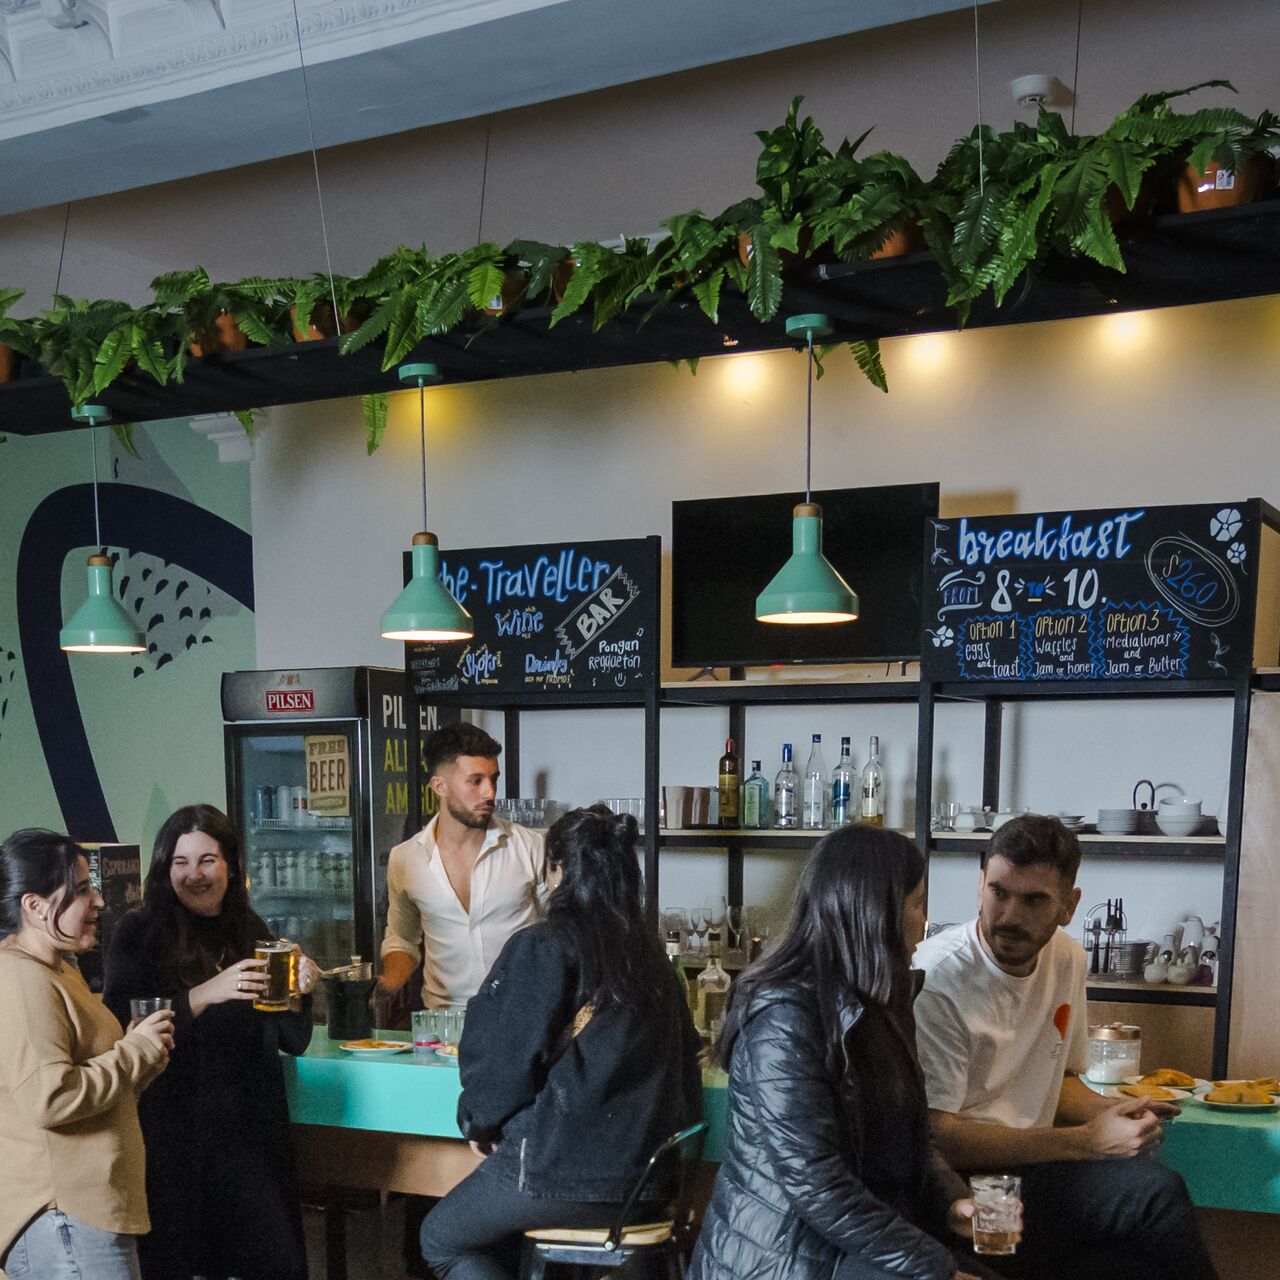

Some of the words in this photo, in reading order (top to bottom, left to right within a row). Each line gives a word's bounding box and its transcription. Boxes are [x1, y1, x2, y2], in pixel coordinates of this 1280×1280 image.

[958, 510, 1145, 565] breakfast
[943, 586, 979, 605] FROM
[990, 569, 1012, 612] 8
[495, 609, 544, 636] Wine
[576, 587, 625, 641] BAR
[1078, 613, 1087, 633] 2
[1147, 609, 1160, 631] 3
[1009, 619, 1016, 639] 1
[965, 641, 990, 661] eggs
[1035, 637, 1077, 657] Waffles
[1124, 647, 1141, 659] and
[977, 660, 992, 668] and
[992, 656, 1021, 678] toast
[1059, 653, 1074, 662] and
[1105, 660, 1129, 676] Jam
[1134, 665, 1143, 675] or
[1148, 656, 1182, 674] Butter
[1032, 662, 1054, 676] Jam
[1056, 667, 1064, 675] or
[267, 693, 312, 709] PILSEN
[382, 694, 441, 731] PILEN.
[309, 759, 346, 793] BEER
